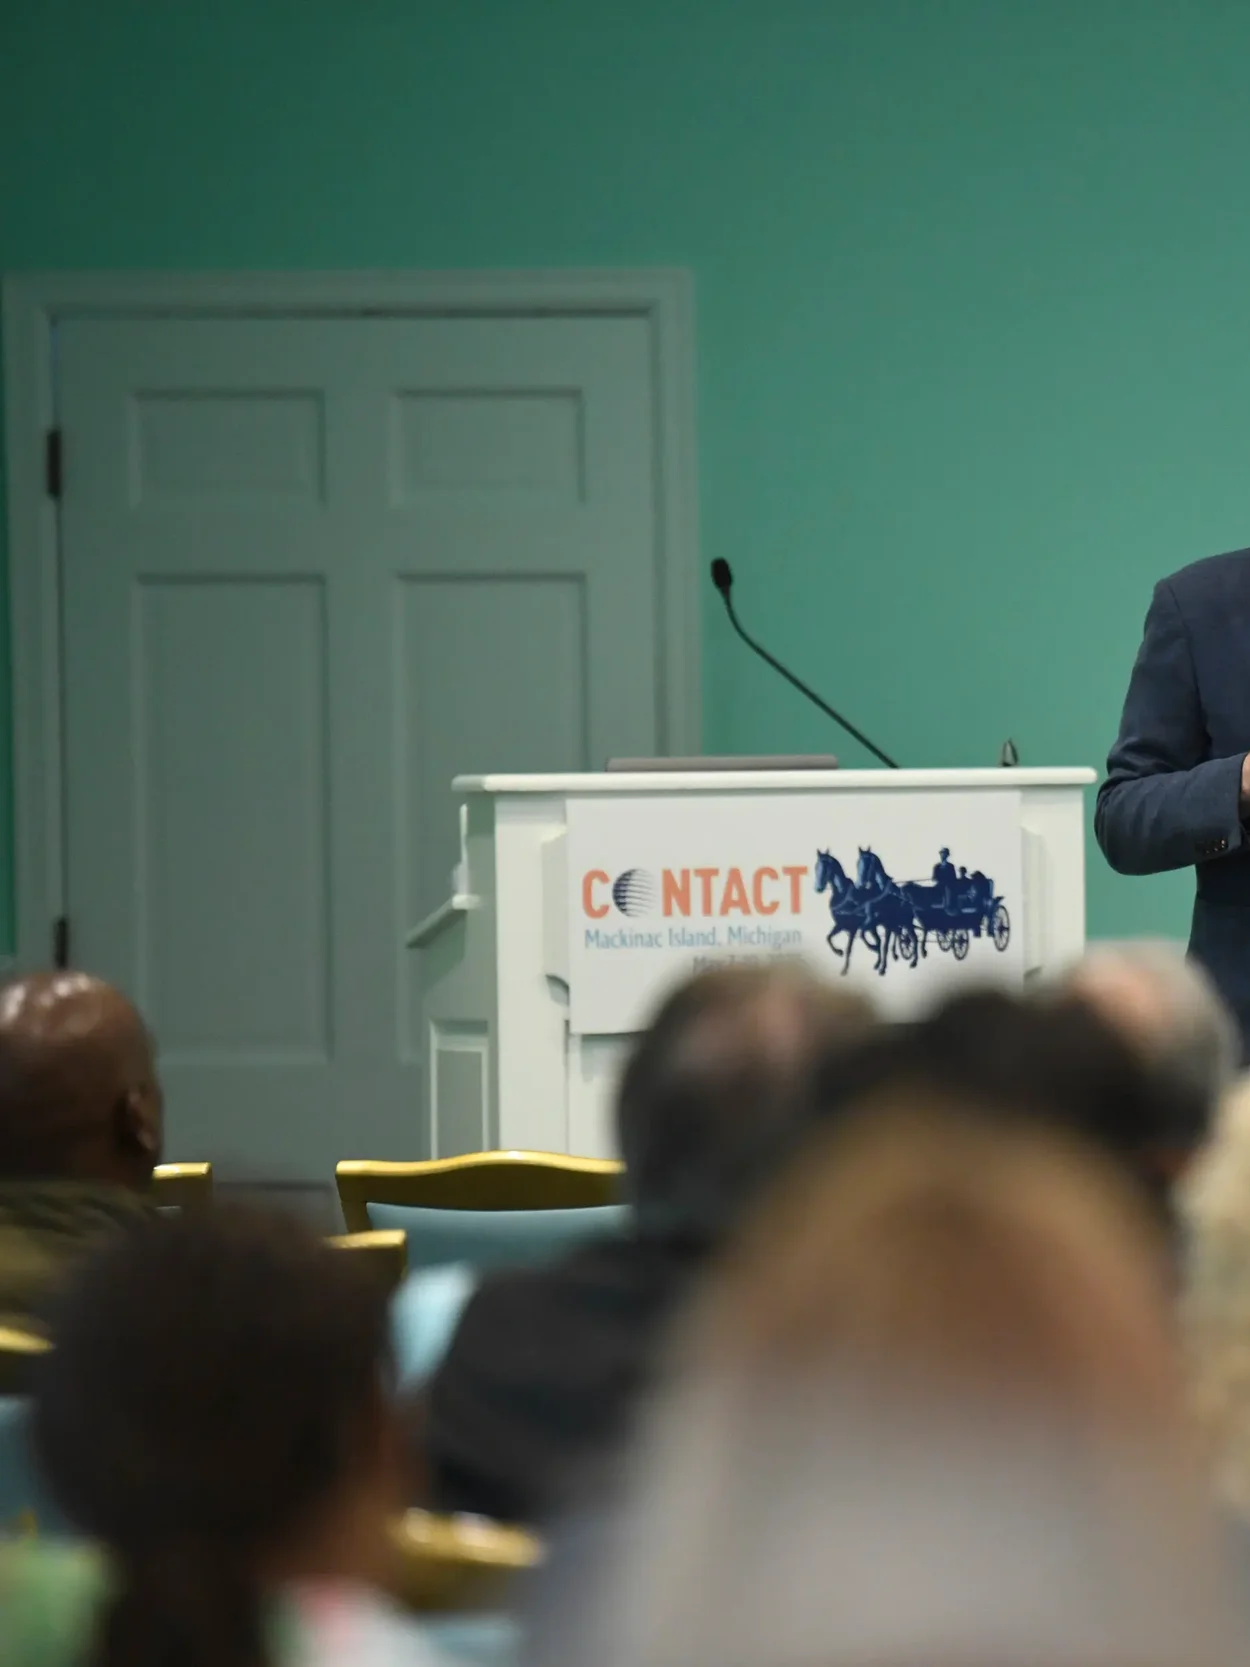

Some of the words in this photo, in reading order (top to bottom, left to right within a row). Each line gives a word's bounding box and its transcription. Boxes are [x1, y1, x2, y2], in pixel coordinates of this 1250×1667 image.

[584, 929, 662, 949] Mackinac
[668, 927, 722, 948] Island,
[727, 925, 802, 950] Michigan
